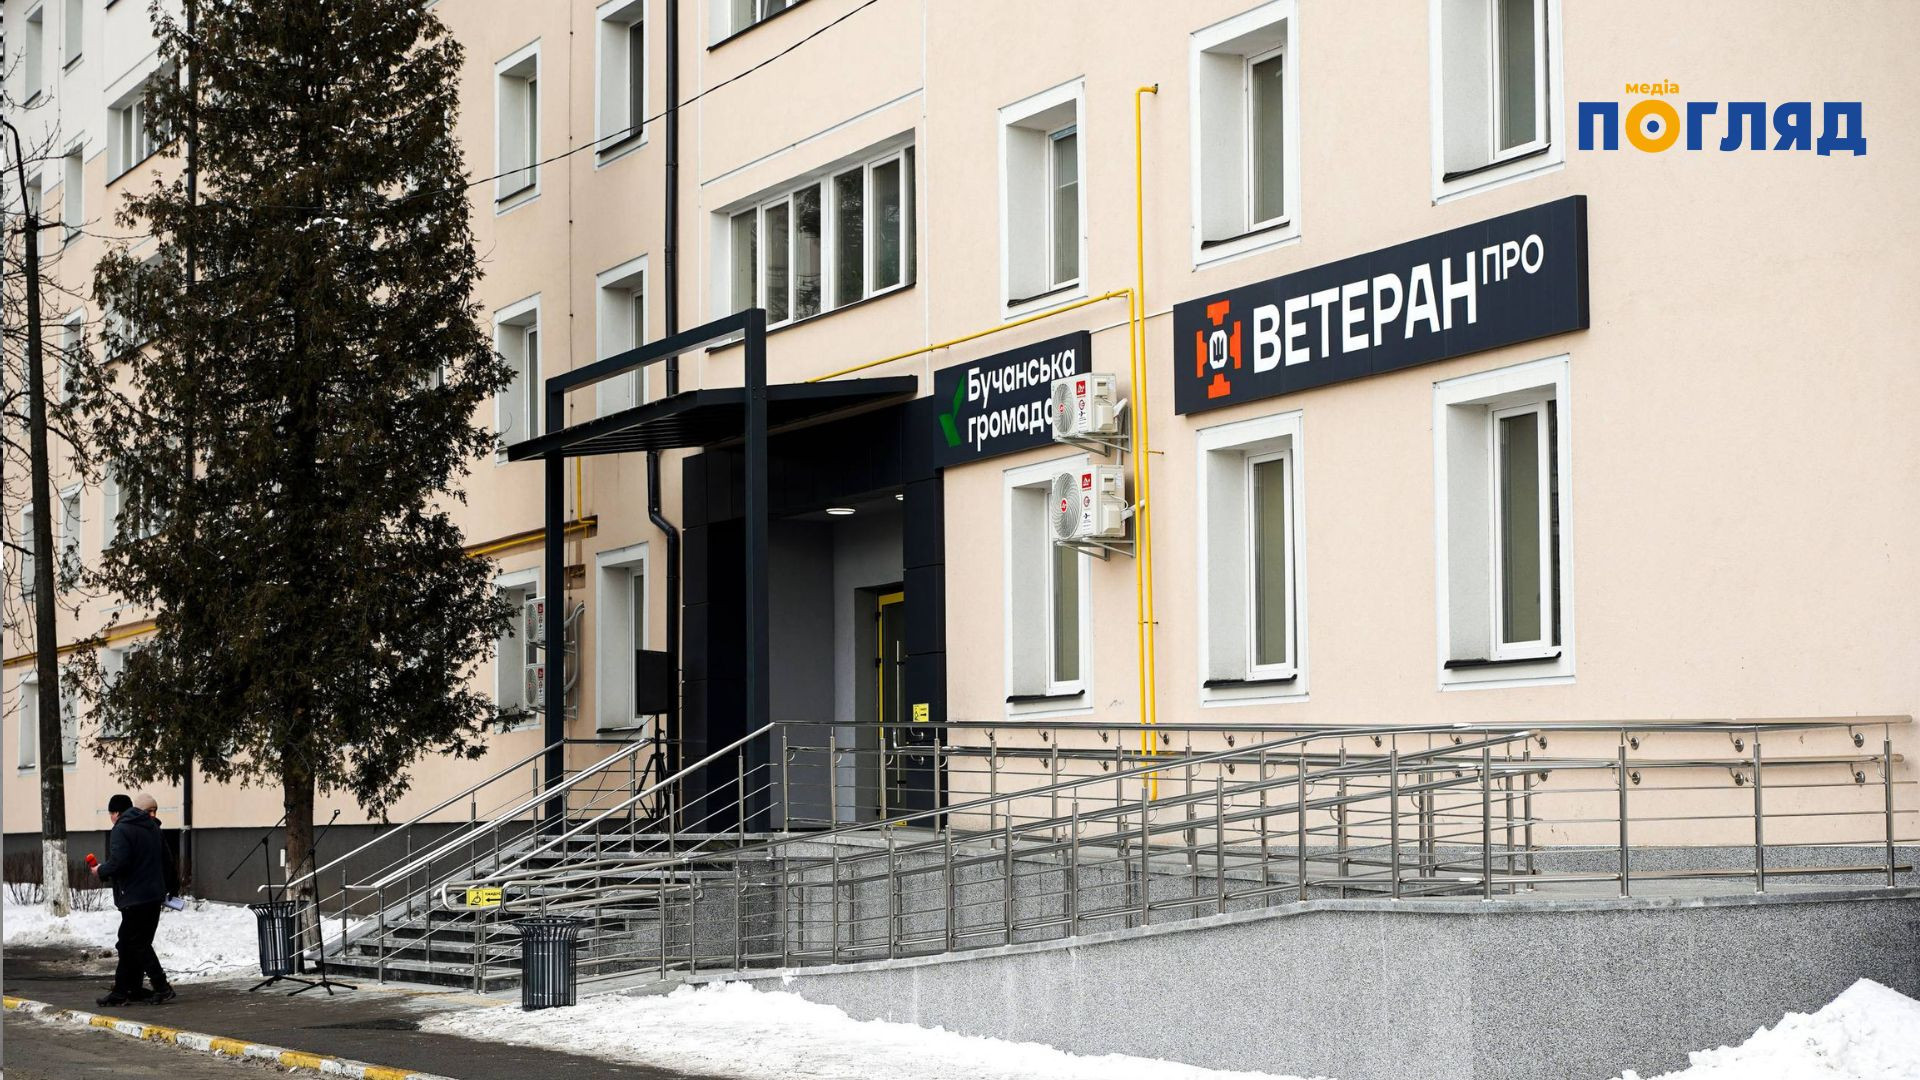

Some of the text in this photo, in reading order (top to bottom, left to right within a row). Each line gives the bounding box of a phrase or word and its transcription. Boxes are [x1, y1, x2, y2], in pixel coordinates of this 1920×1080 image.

[1253, 233, 1544, 374] ВЕТЕРАН ПРО
[968, 348, 1076, 409] Бучанська
